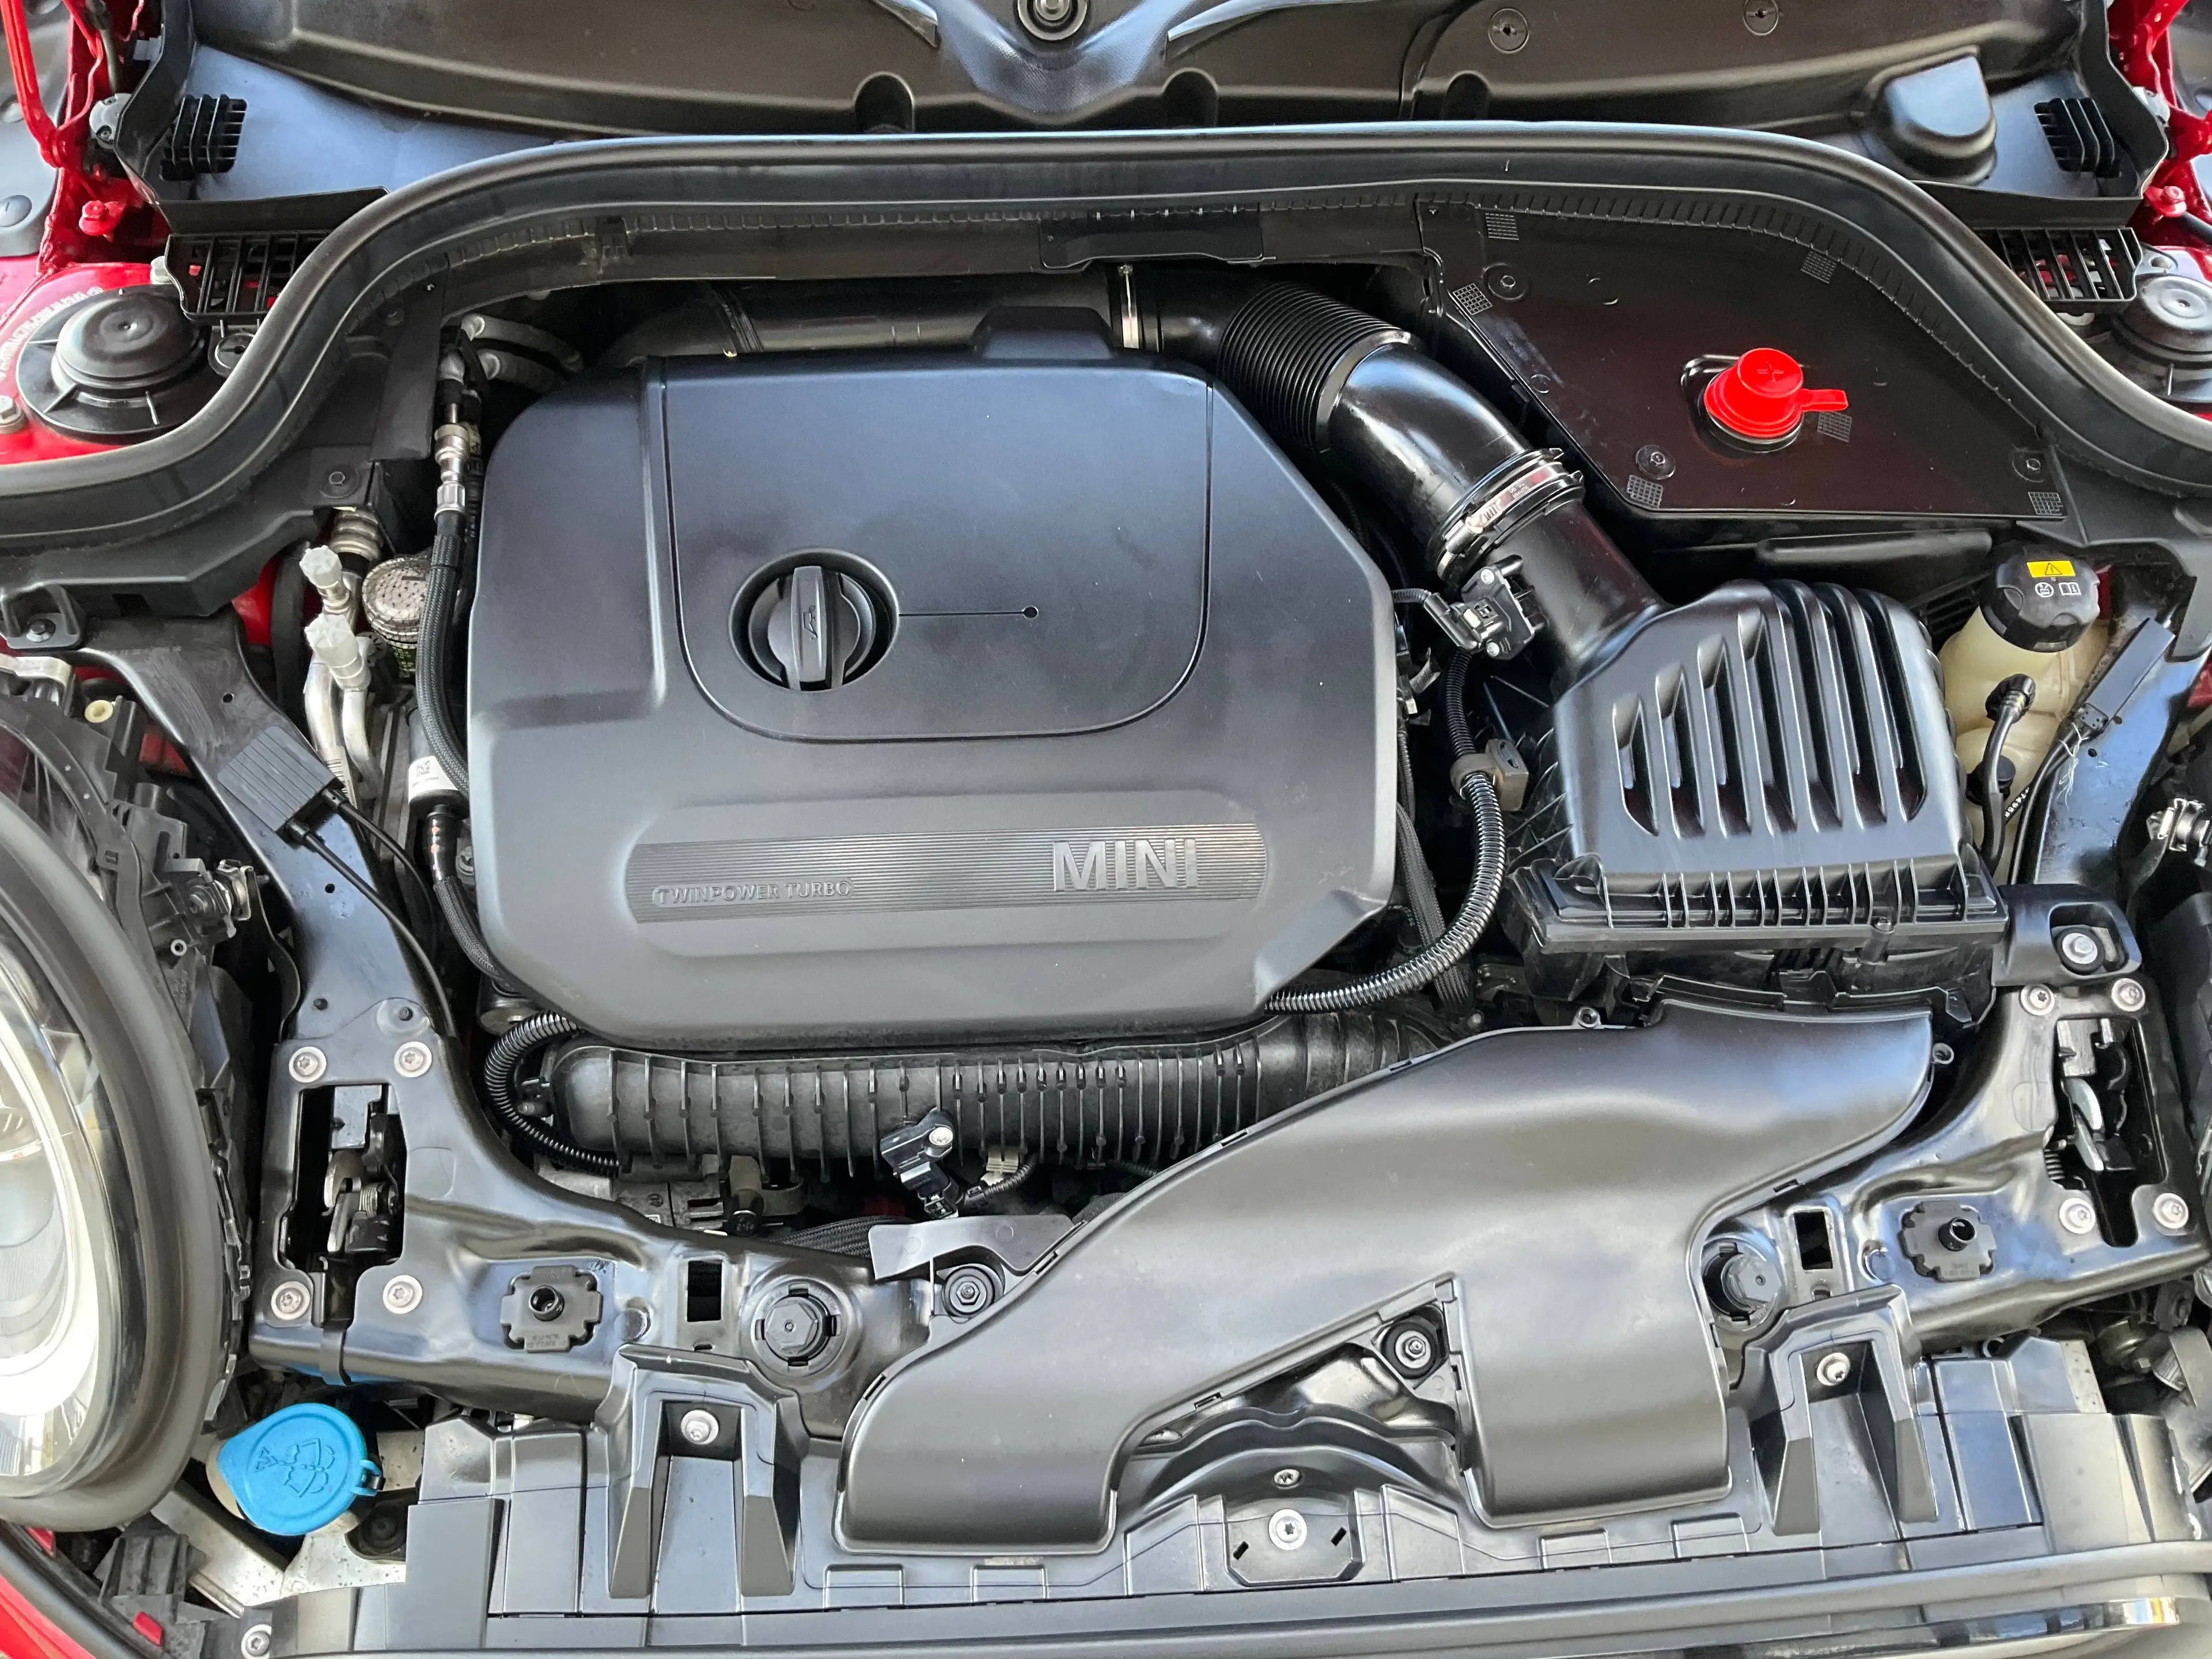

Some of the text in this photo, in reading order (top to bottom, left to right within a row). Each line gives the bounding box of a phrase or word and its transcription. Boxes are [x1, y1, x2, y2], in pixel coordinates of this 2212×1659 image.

[1053, 838, 1198, 892] MINI
[657, 880, 851, 904] TWINPOWER TURBO
